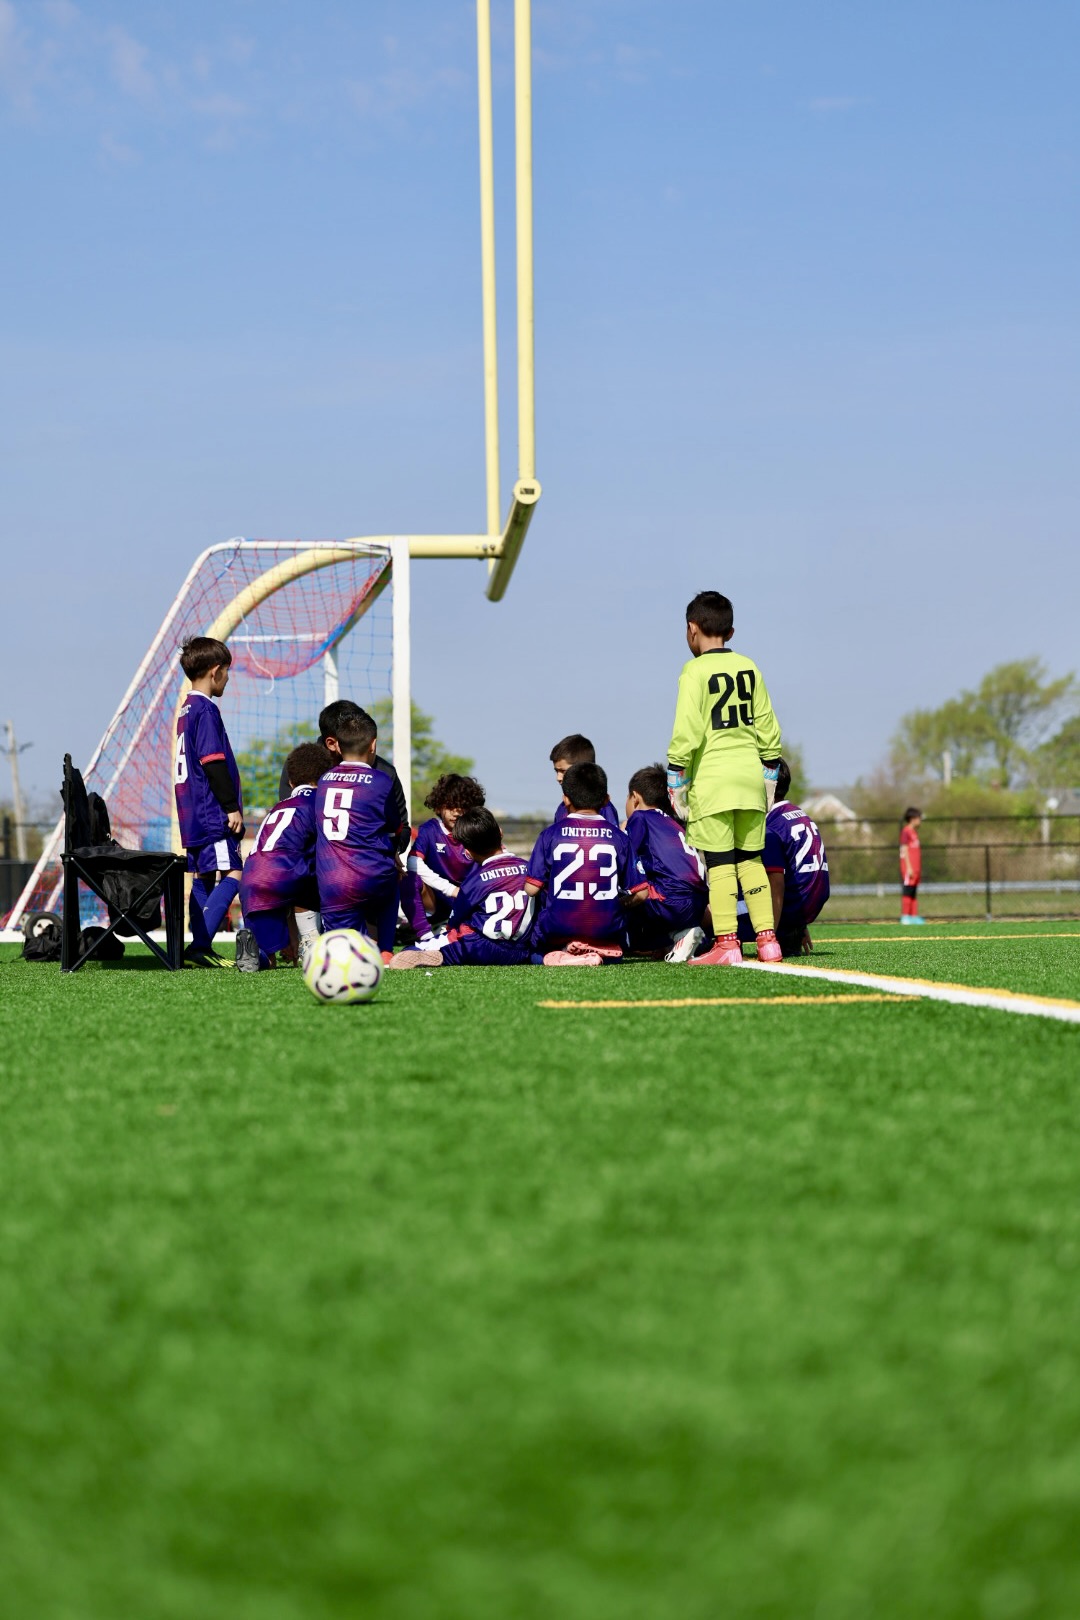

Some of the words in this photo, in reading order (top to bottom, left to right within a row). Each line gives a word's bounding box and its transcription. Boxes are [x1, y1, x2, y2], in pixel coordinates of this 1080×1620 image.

[708, 670, 755, 730] 29
[323, 772, 357, 783] UNITED
[358, 774, 373, 784] FC
[323, 787, 354, 841] 5
[561, 827, 600, 837] UNITED
[600, 829, 613, 838] FC
[480, 868, 520, 882] UNITED
[553, 843, 618, 900] 23
